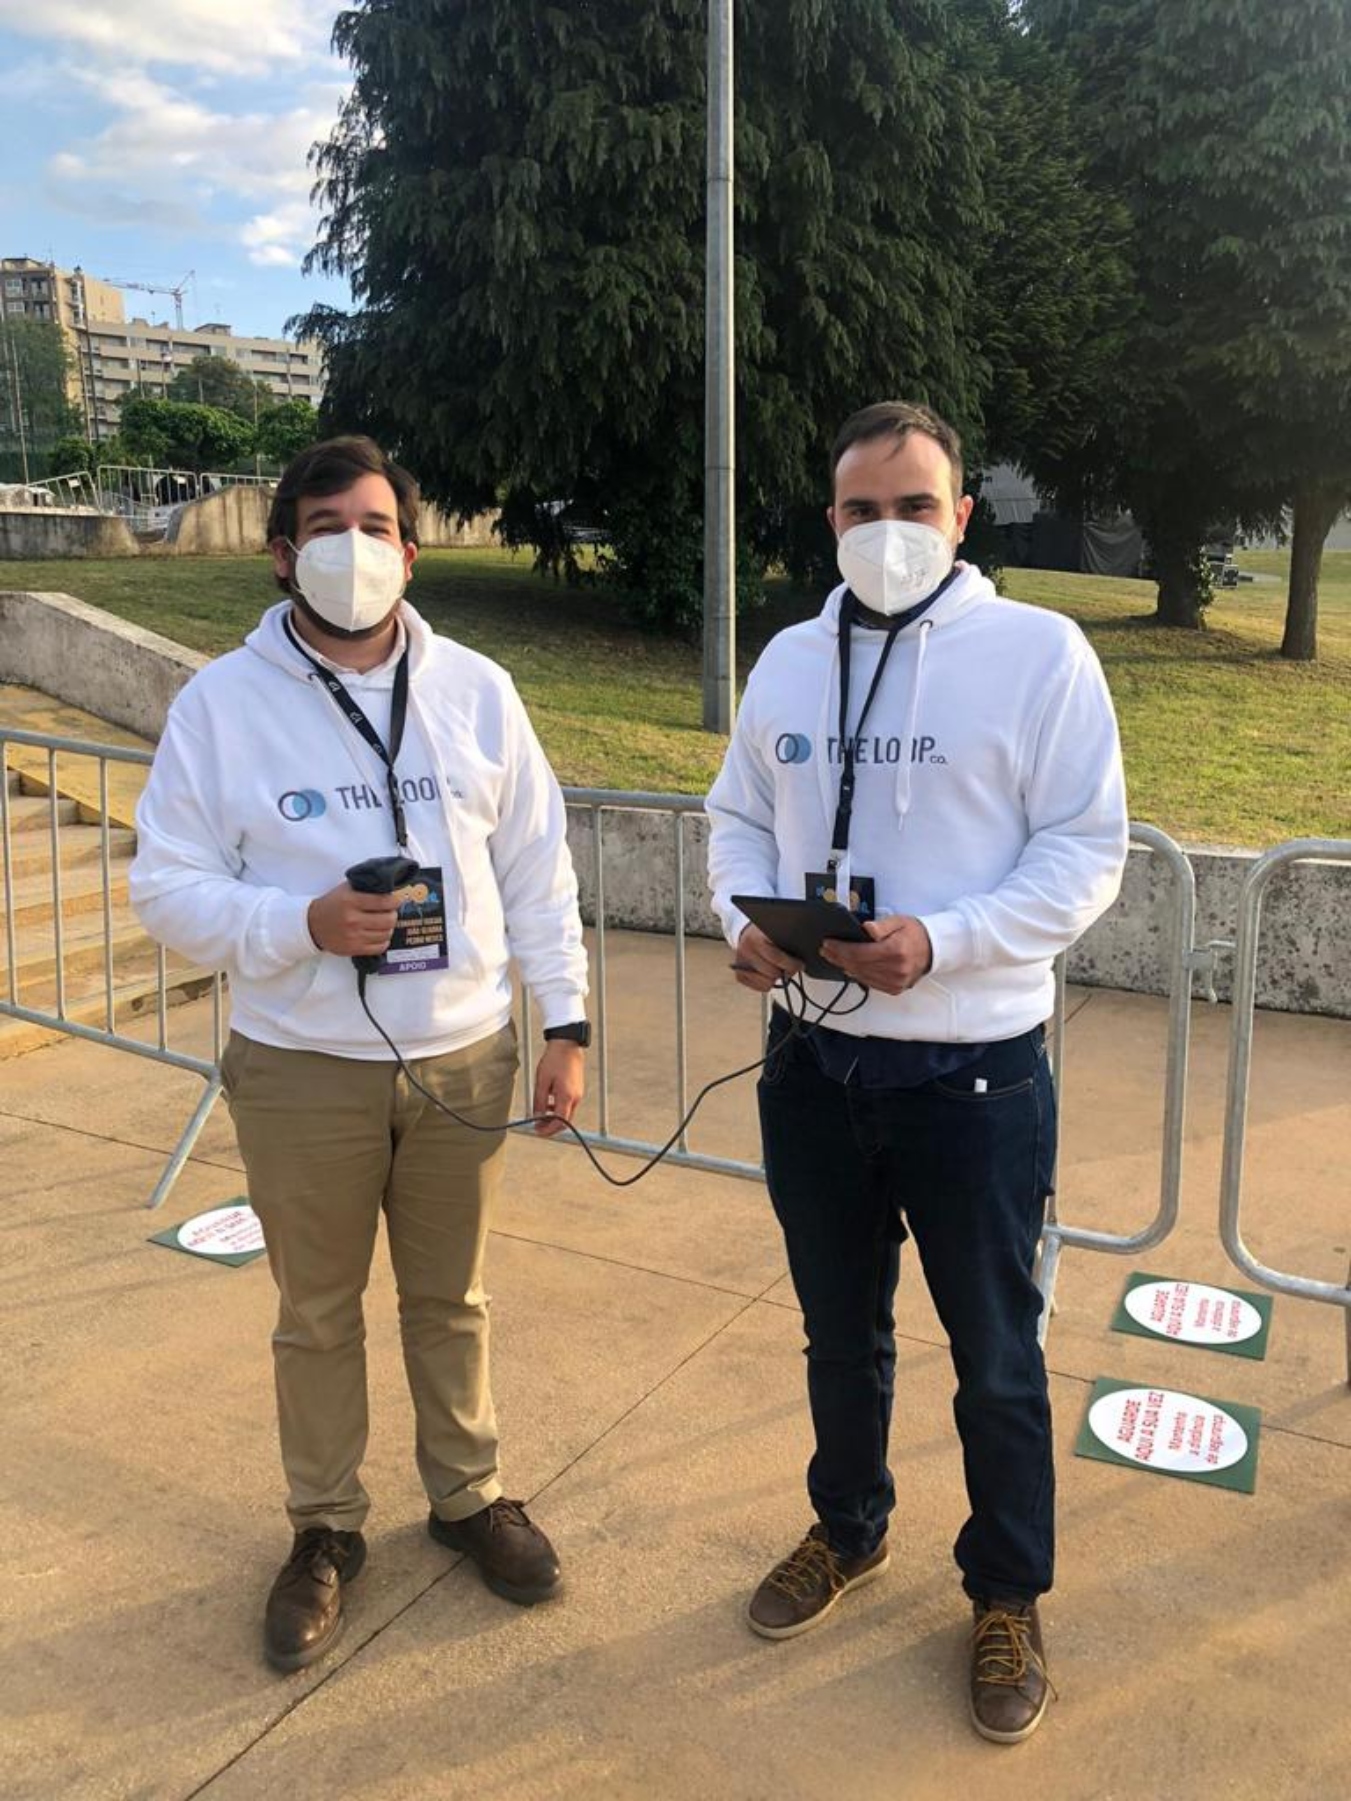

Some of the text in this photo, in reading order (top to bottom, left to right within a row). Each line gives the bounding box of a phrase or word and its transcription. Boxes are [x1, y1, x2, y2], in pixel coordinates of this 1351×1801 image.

[399, 961, 427, 971] APOIO
[1147, 1391, 1164, 1408] VEZ
[1117, 1398, 1141, 1443] AGUARDE
[1142, 1410, 1159, 1429] SUA
[1134, 1436, 1154, 1461] AQUI
